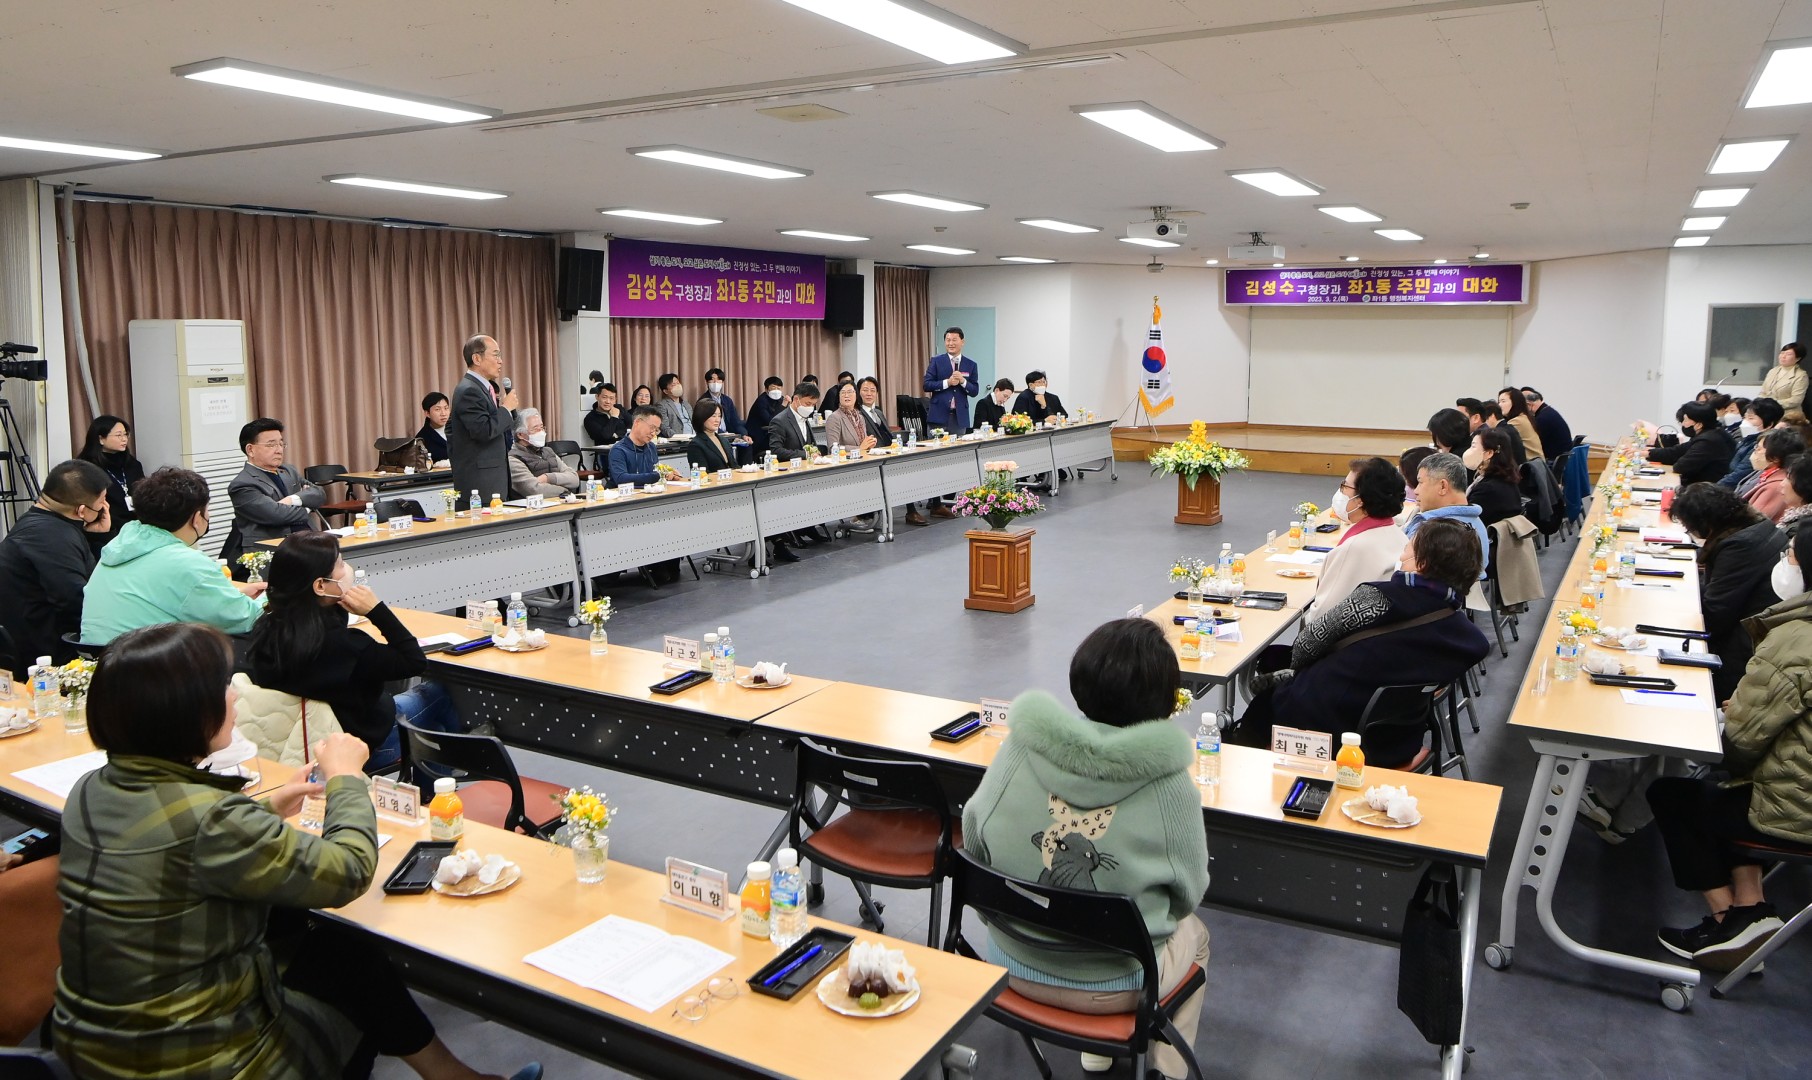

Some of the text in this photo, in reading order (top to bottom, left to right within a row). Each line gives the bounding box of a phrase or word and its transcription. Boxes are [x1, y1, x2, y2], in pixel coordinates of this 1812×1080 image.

[733, 261, 749, 272] 진정성
[750, 262, 762, 273] 있는,
[763, 263, 768, 272] 그
[769, 263, 774, 273] 두
[786, 265, 801, 275] 이야기
[1370, 269, 1389, 278] 진정성
[1391, 269, 1406, 277] 있는,
[1438, 268, 1460, 276] 이야기
[627, 273, 673, 301] 김성수
[675, 284, 712, 302] 구청장과
[716, 278, 749, 303] 좌1동
[795, 282, 816, 305] 대화
[1245, 280, 1295, 296] 김성수
[1296, 284, 1342, 296] 구청장과
[1347, 278, 1392, 295] 좌1동
[1462, 277, 1499, 294] 대화
[666, 646, 697, 660] 나근호
[1275, 739, 1329, 759] 최말순
[378, 795, 413, 816] 김영순
[673, 880, 721, 907] 이미향
